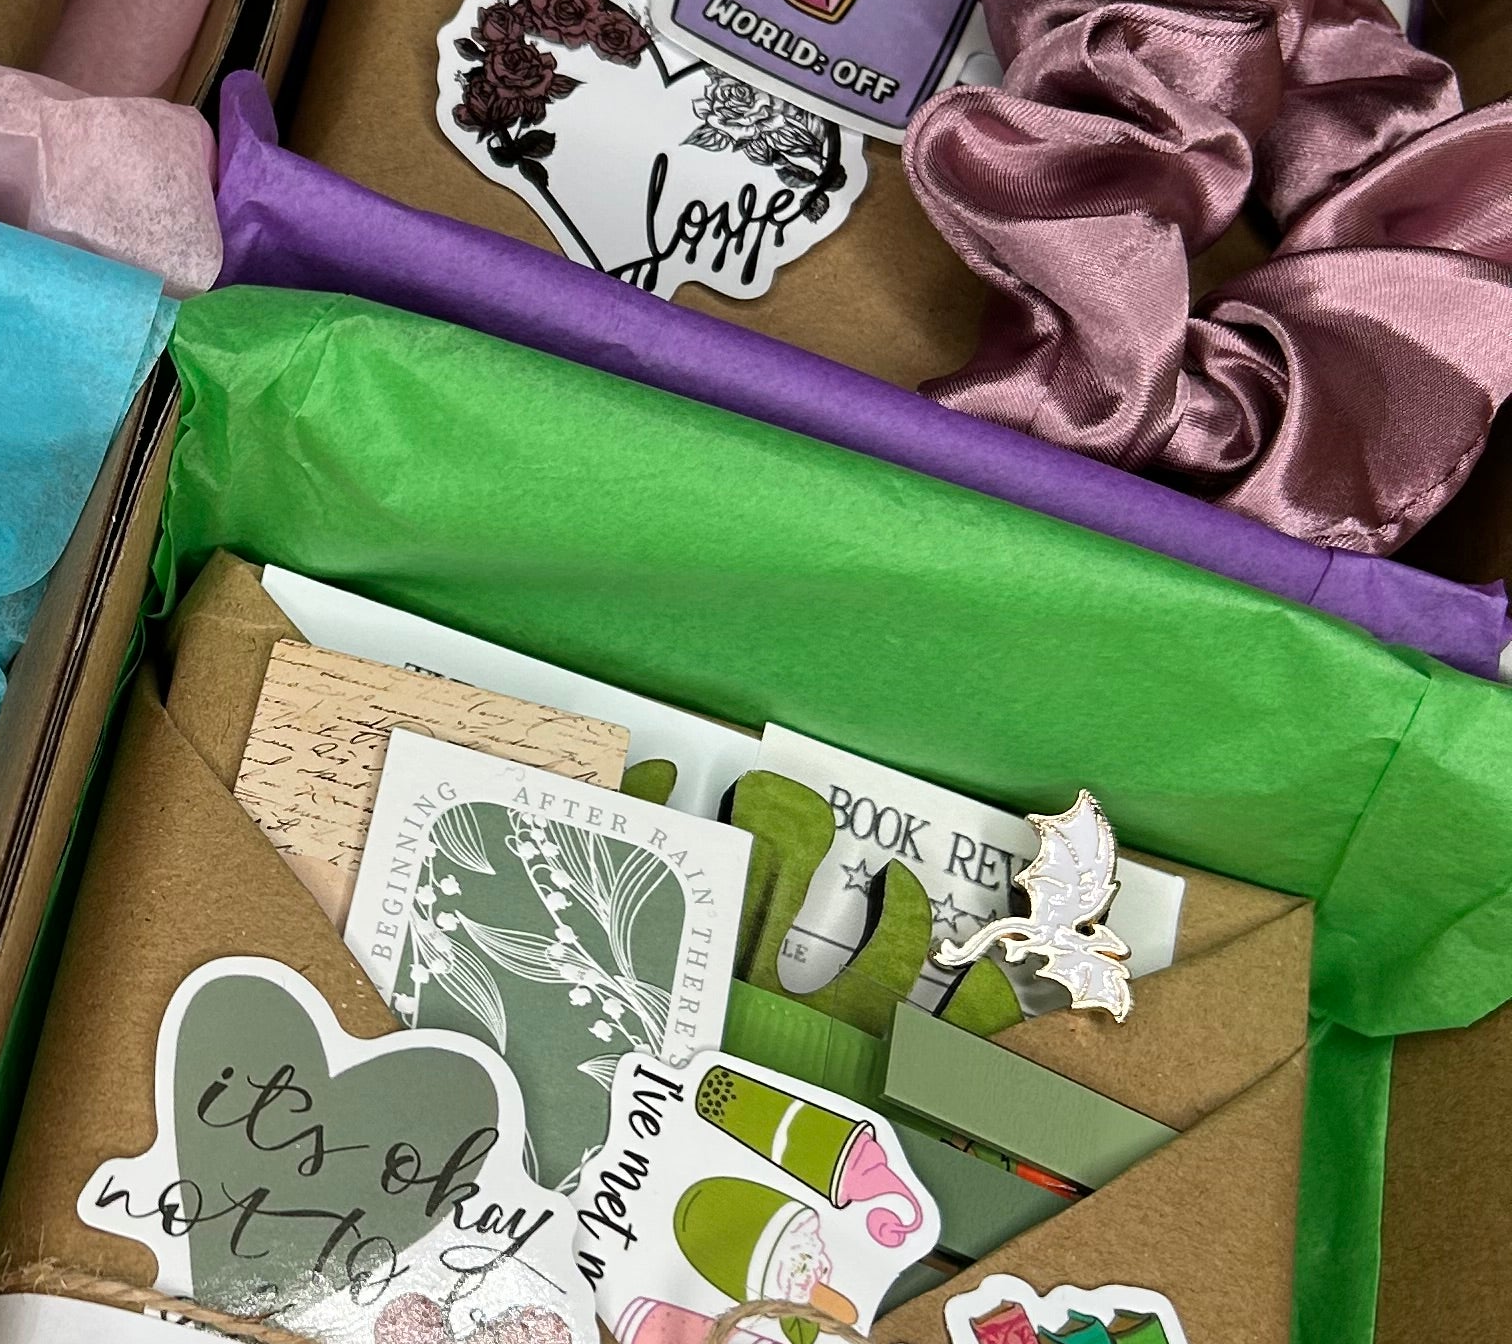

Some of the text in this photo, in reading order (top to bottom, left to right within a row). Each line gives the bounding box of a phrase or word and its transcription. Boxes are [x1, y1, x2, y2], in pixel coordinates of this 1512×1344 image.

[830, 58, 900, 105] OFF
[646, 151, 800, 286] love
[371, 779, 459, 962] BEGINNING
[512, 785, 628, 836] AFTER
[646, 827, 715, 911] RAIN
[829, 784, 931, 864] BOOK
[626, 1062, 685, 1139] I've
[94, 1174, 291, 1261] not
[380, 1126, 567, 1296] okay
[577, 1147, 651, 1252] met
